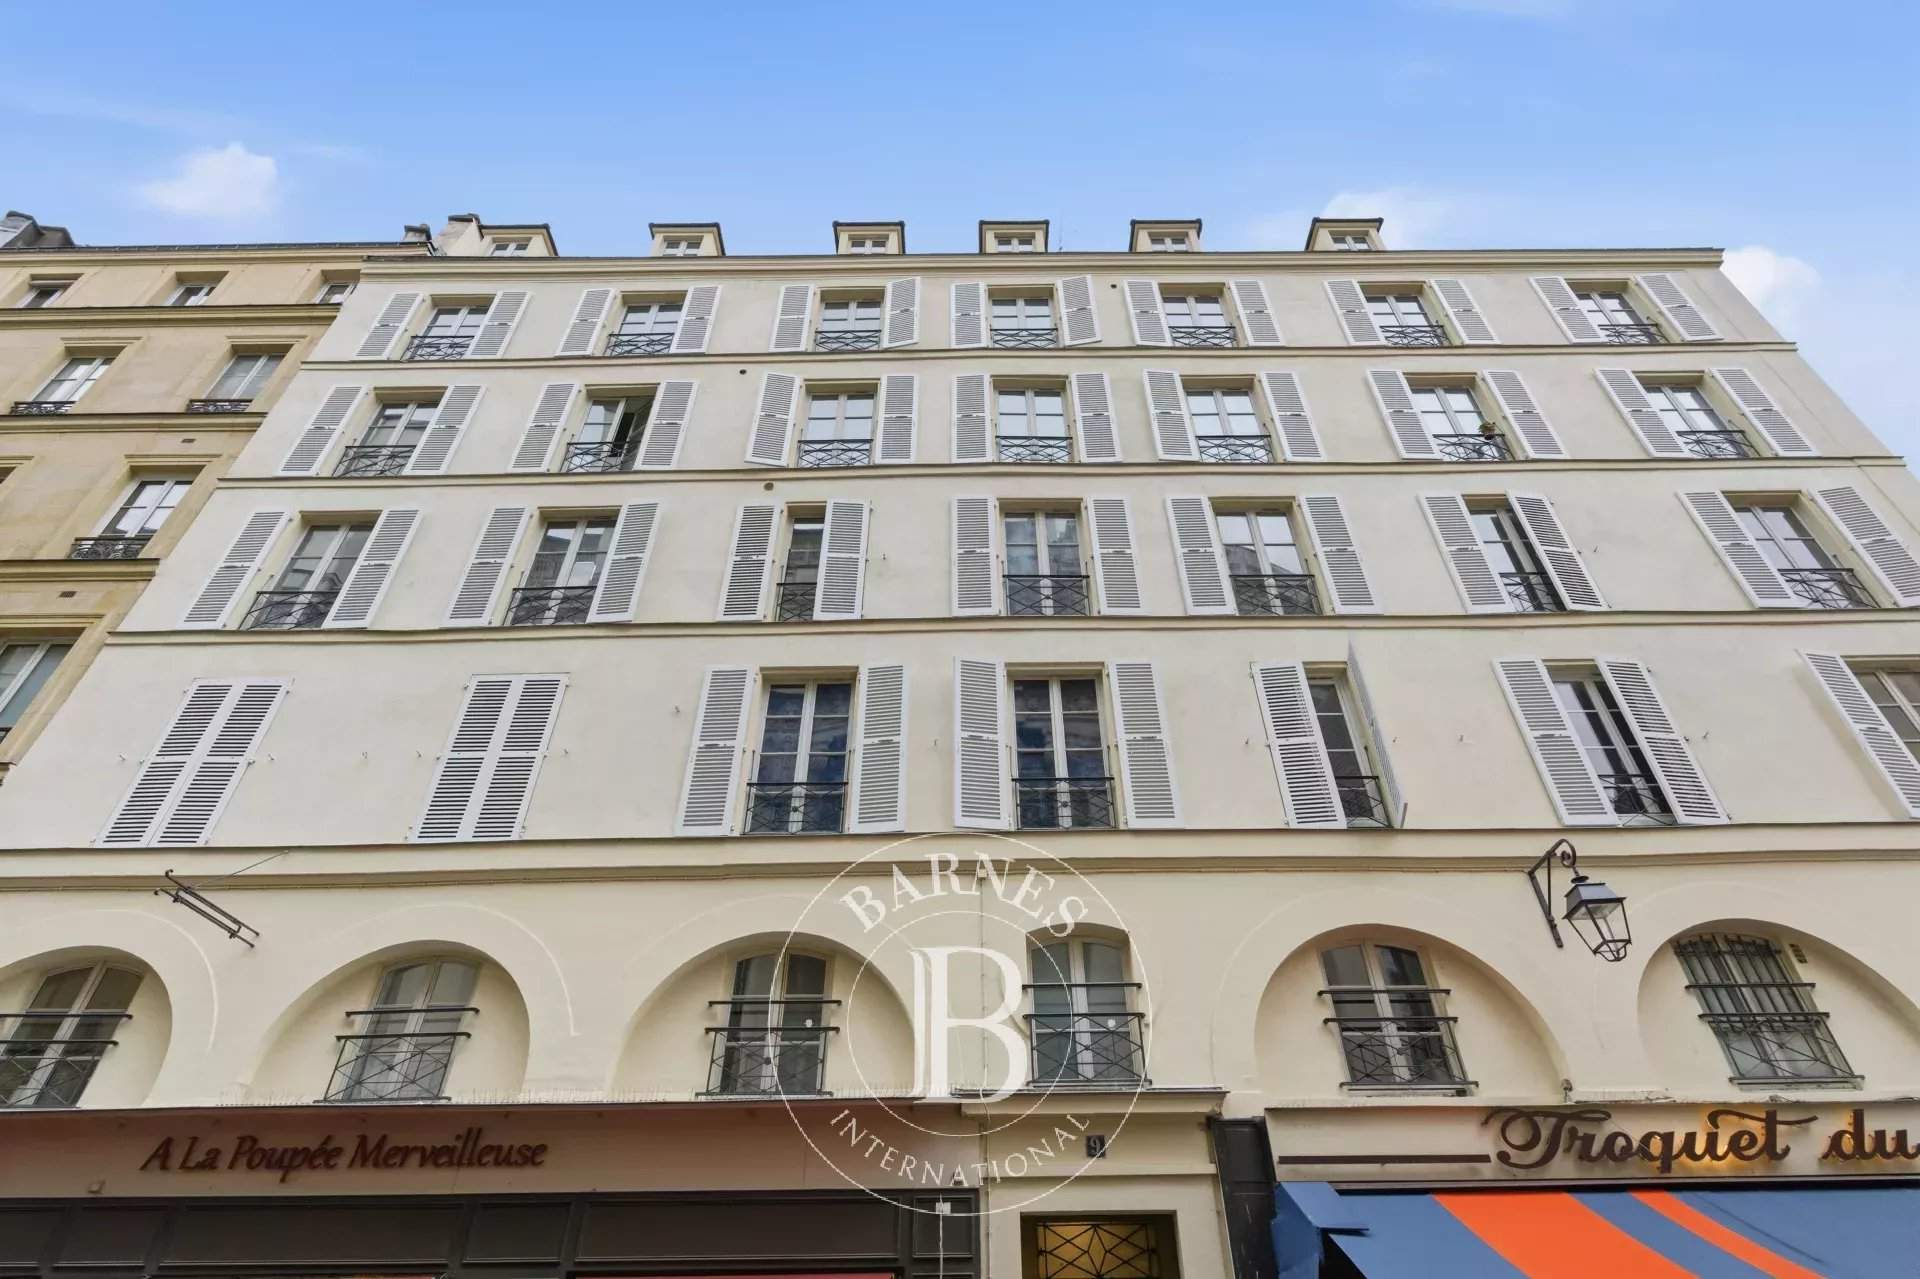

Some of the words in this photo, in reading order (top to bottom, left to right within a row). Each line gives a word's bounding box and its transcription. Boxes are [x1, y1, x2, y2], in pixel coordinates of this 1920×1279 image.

[139, 1136, 174, 1171] A
[178, 1136, 221, 1171] La
[226, 1134, 344, 1184] Poupée
[347, 1127, 549, 1169] Merveilleuse
[1481, 1108, 1819, 1174] Troquet
[1821, 1108, 1920, 1161] du
